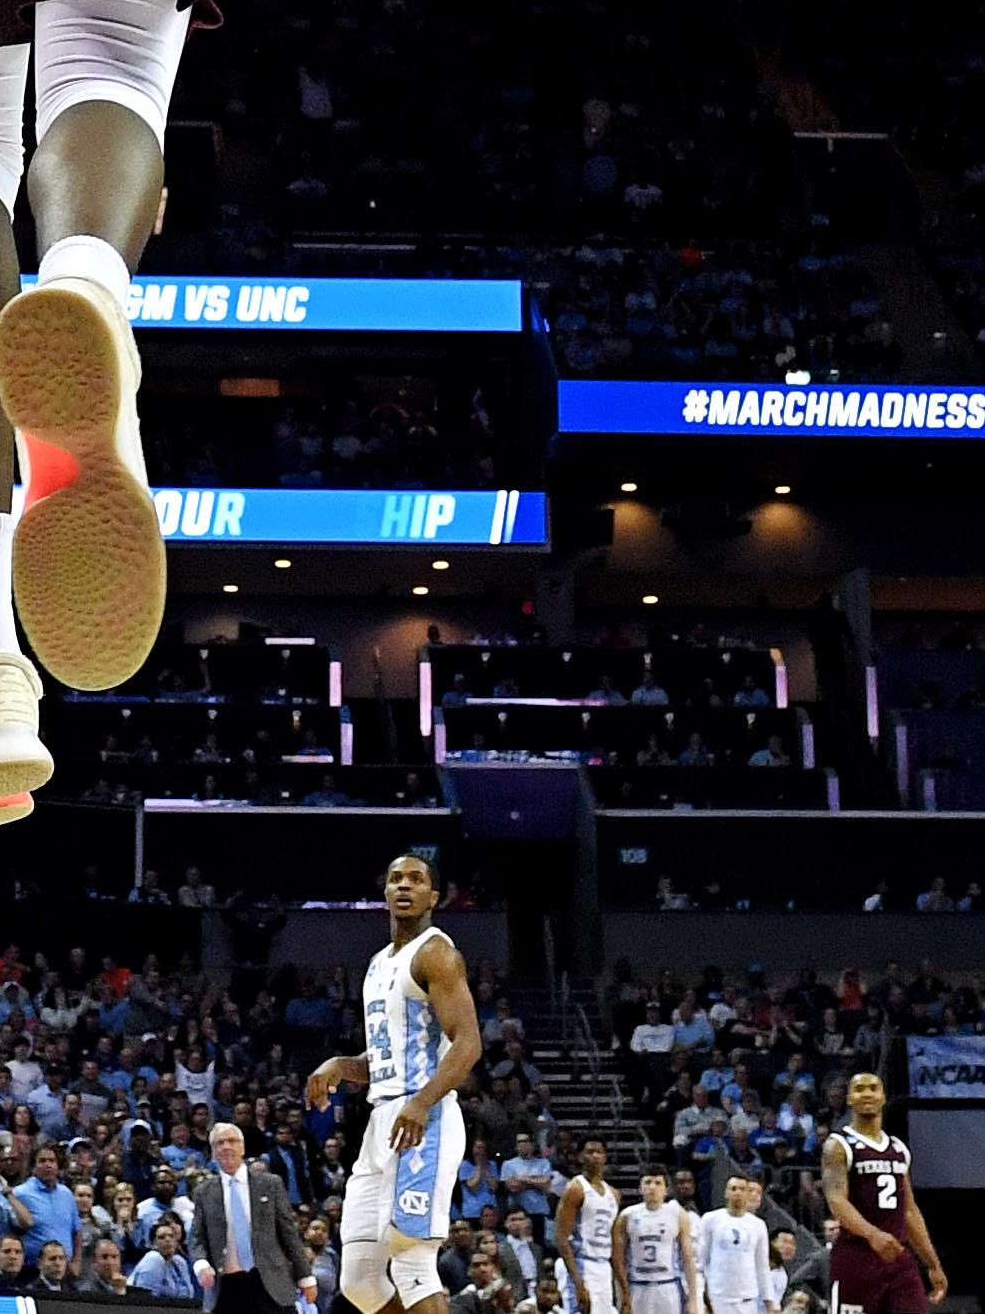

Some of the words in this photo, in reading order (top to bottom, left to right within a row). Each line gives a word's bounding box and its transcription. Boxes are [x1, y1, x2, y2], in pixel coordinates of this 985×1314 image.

[184, 285, 231, 321] VS
[236, 285, 310, 323] UNC
[682, 389, 985, 429] #MARCHMADNESS
[153, 490, 245, 536] OUR
[381, 494, 455, 538] HIP
[877, 1174, 898, 1209] 2
[643, 1245, 657, 1263] 3
